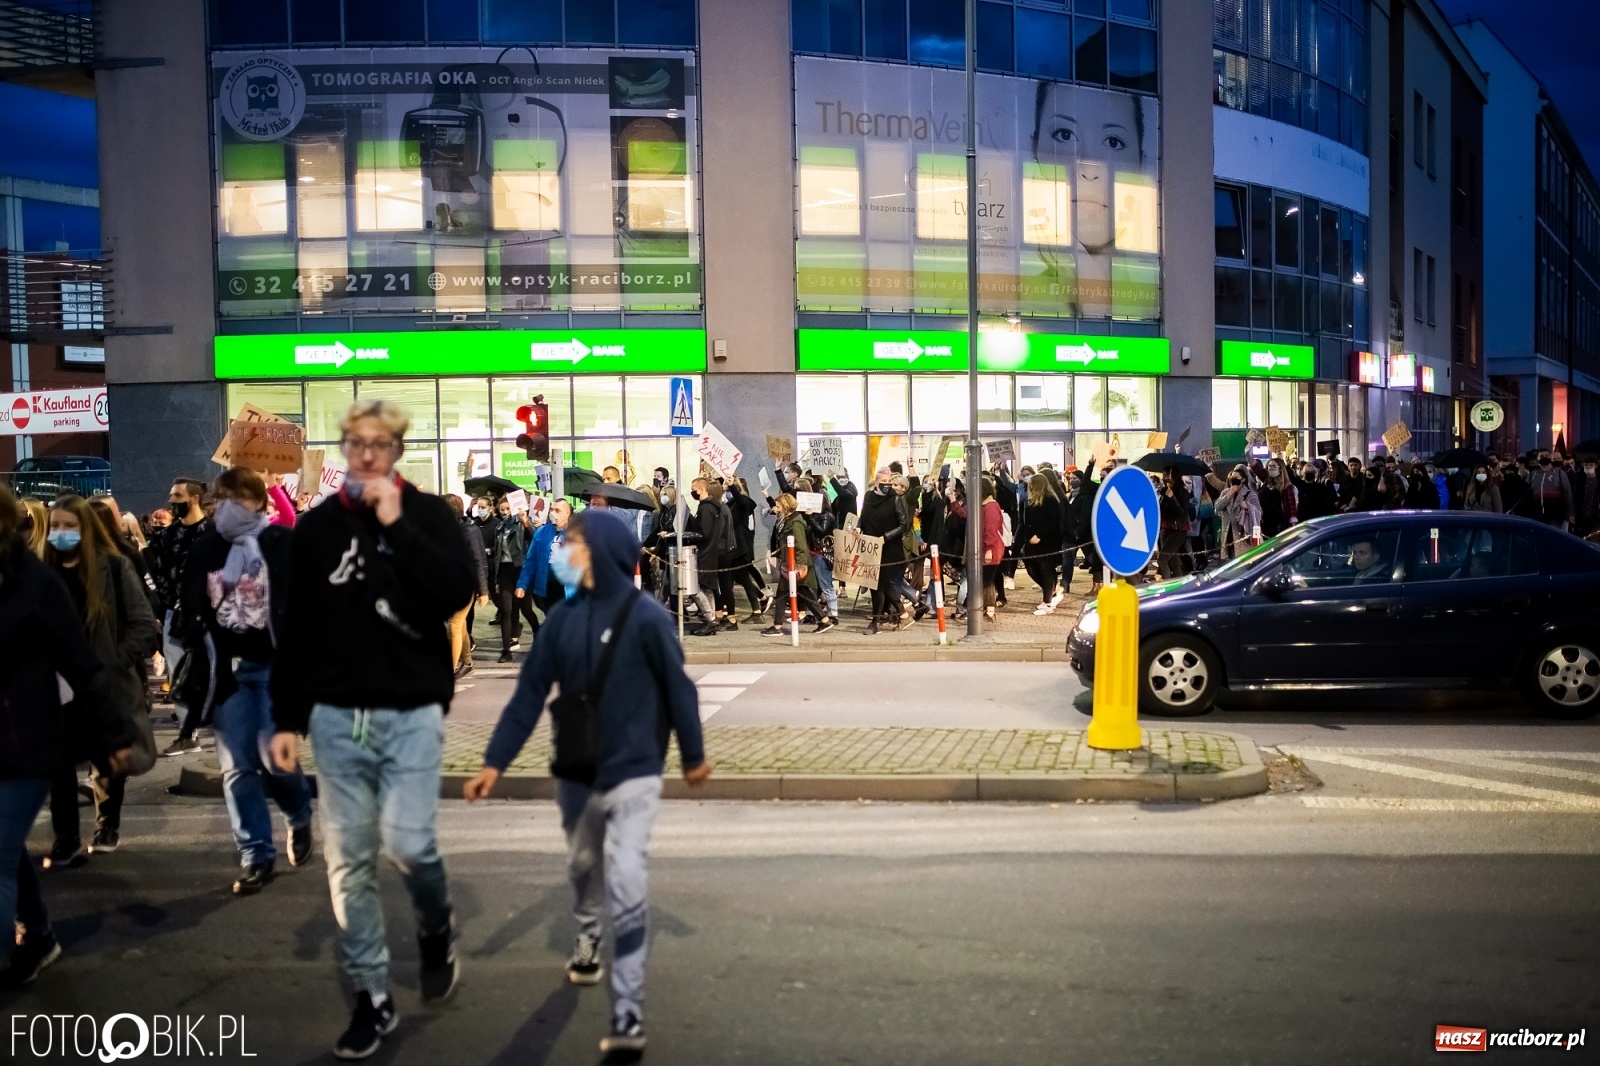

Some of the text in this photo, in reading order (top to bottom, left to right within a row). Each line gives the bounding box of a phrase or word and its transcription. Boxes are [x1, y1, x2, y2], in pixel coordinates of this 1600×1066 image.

[228, 58, 296, 82] ZAKŁAD OPTYCZNY
[312, 72, 433, 87] TOMOGRAFIA
[439, 71, 477, 85] OKA
[489, 76, 510, 85] OCT
[513, 76, 543, 87] Angio
[546, 76, 570, 86] Scan
[575, 76, 605, 86] Nidek
[870, 203, 915, 213] bezpieczna
[918, 207, 948, 215] metoda
[254, 273, 410, 294] 32 415 27 21
[453, 271, 691, 289] www.optyk-raciborz.pl
[819, 276, 900, 288] 32 415 23 39
[918, 279, 1046, 295] www.fabykaurody.eu
[43, 395, 91, 410] Kaufland
[53, 417, 80, 428] parking
[711, 443, 725, 459] NIE
[698, 443, 730, 476] ZAKAZ
[835, 557, 852, 576] NIE
